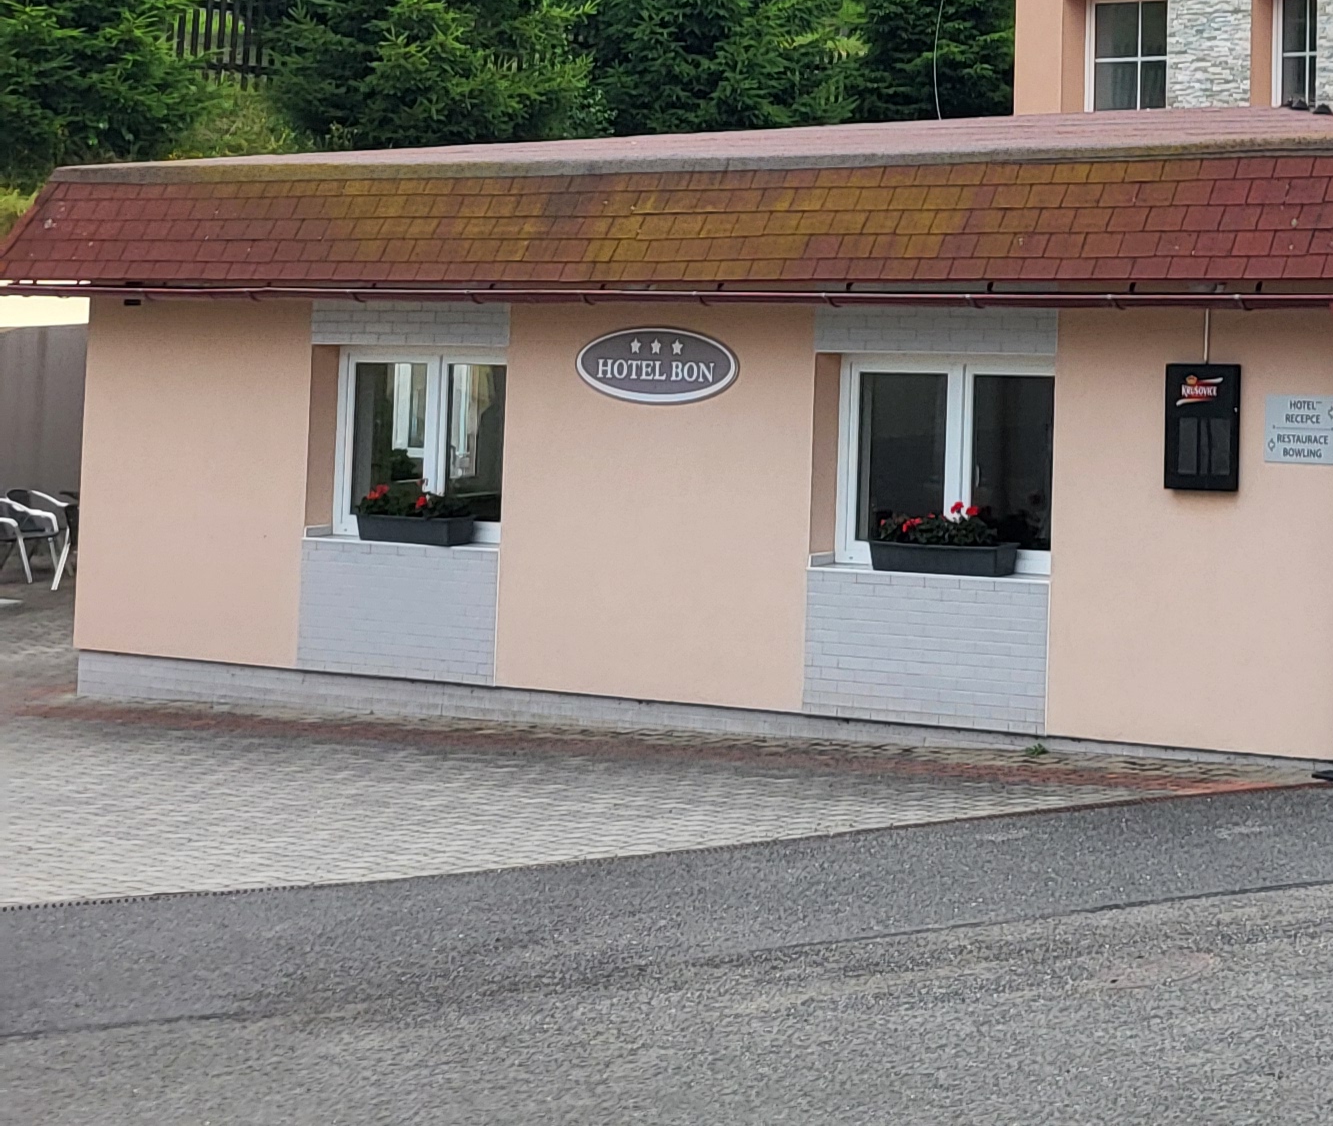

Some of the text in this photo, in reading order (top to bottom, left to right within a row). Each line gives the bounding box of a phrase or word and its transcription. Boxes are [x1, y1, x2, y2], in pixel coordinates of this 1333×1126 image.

[597, 358, 715, 383] HOTEL BON
[1284, 413, 1321, 424] RECEPCE
[1276, 433, 1329, 445] RESTAURACE
[1282, 447, 1323, 459] BOWLING
